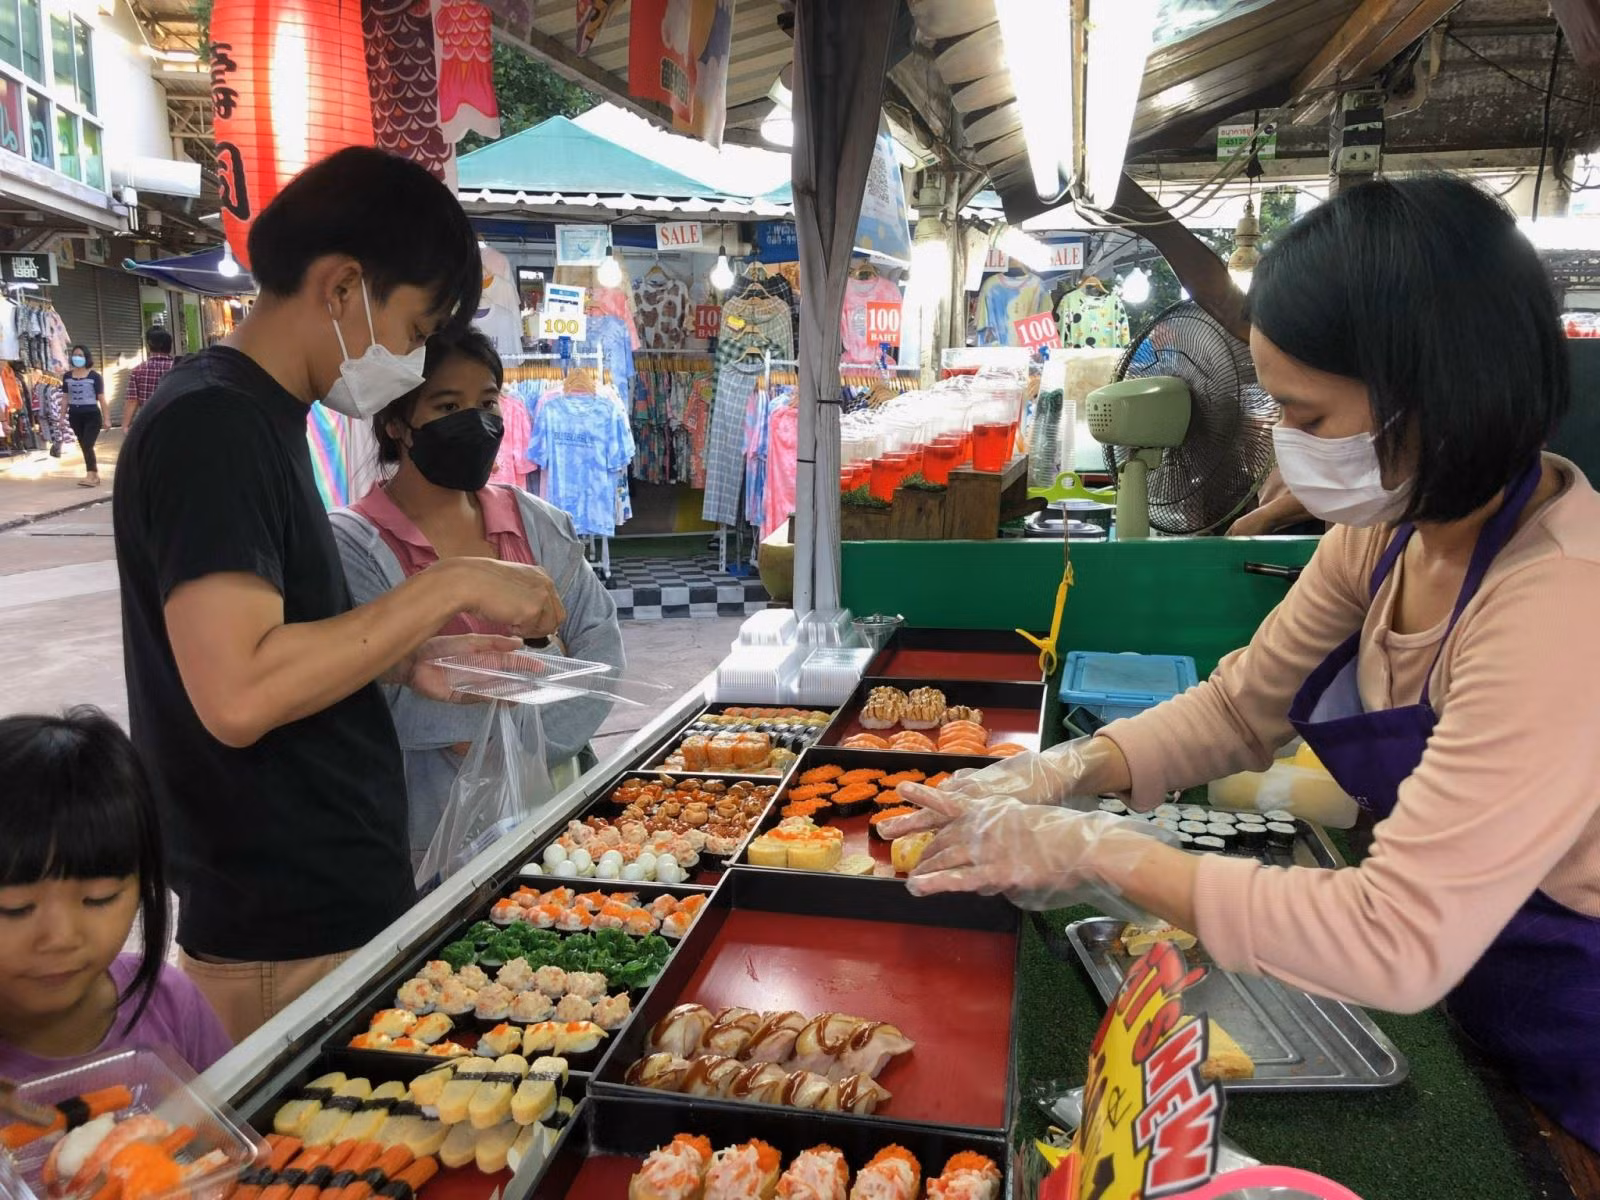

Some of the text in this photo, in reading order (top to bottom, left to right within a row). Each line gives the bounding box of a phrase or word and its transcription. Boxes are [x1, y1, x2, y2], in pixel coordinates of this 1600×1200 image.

[661, 224, 699, 246] SALE
[1050, 247, 1081, 267] ALE
[544, 319, 579, 335] 100
[697, 309, 720, 328] 10
[868, 308, 900, 332] 100
[870, 333, 898, 342] BAHT
[1017, 317, 1056, 345] 100
[1135, 1017, 1218, 1197] NEW
